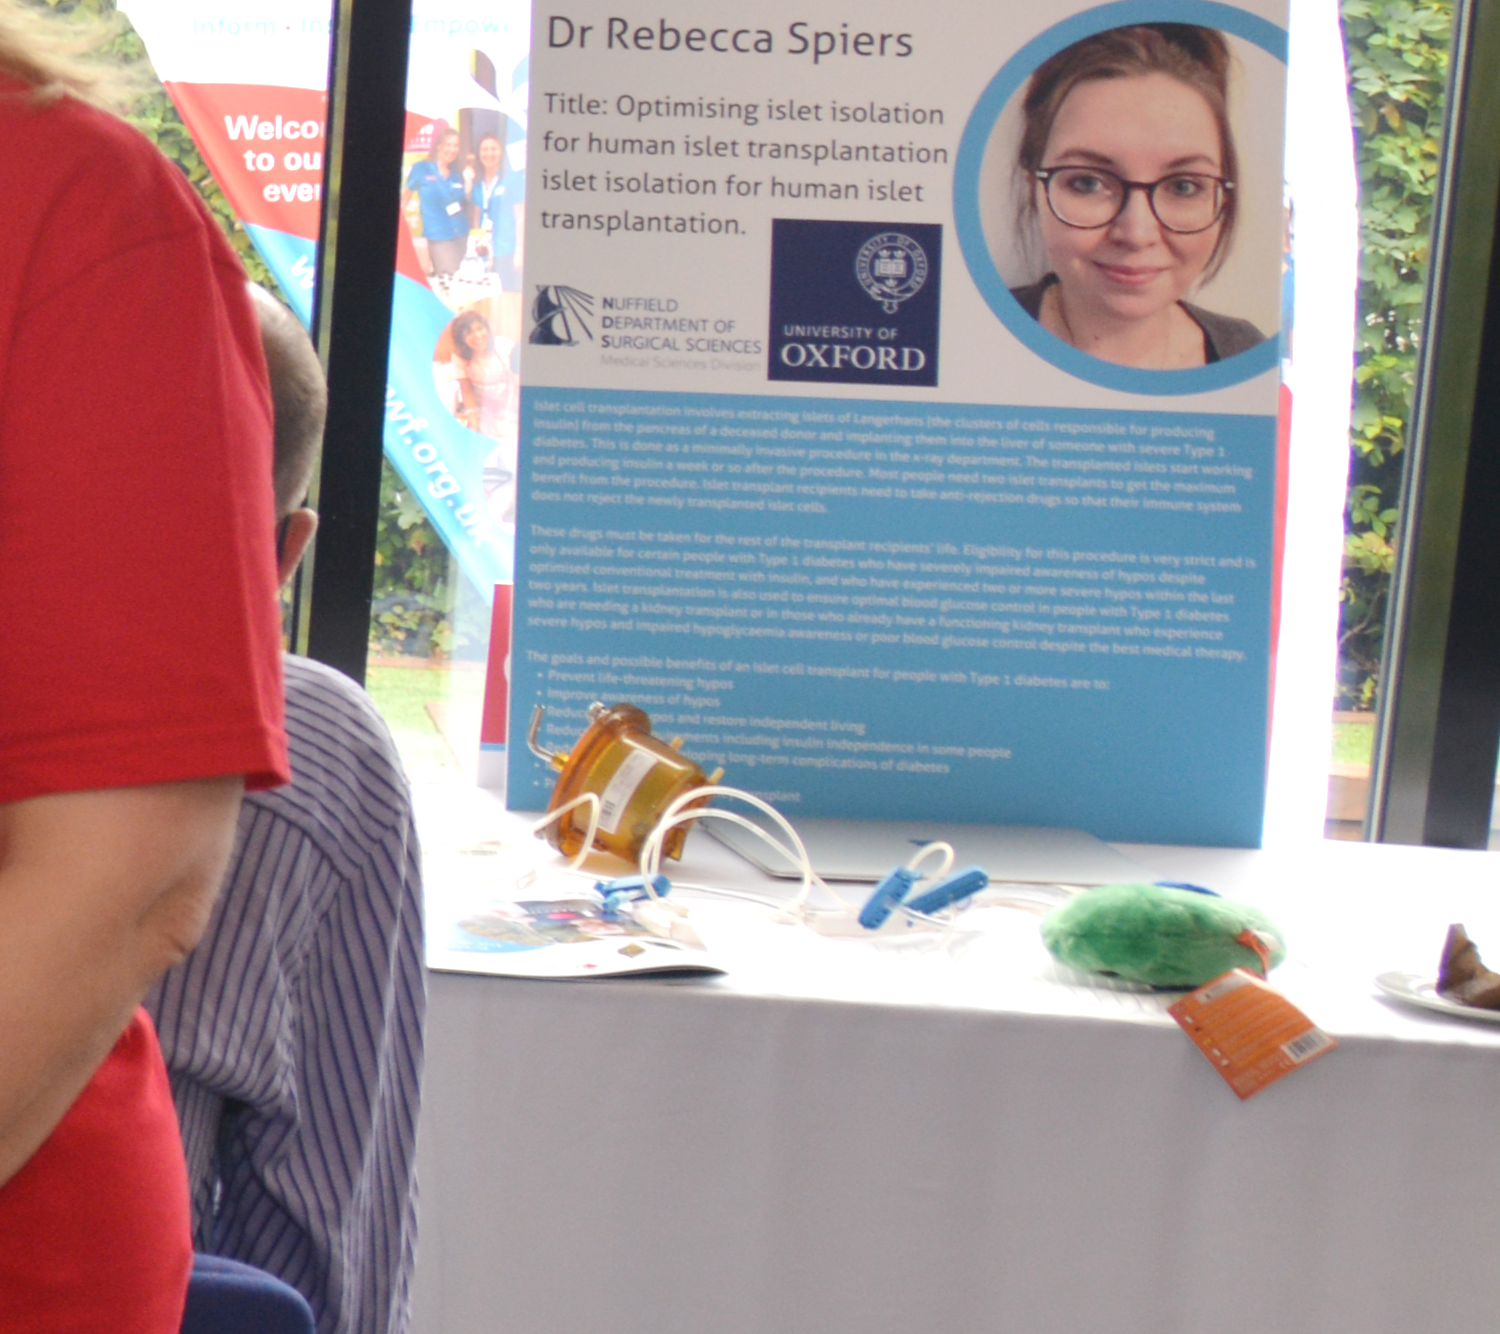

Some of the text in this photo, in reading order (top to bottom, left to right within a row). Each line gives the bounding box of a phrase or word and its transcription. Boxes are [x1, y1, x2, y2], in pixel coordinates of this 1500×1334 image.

[548, 15, 912, 62] Dr Rebecca Spiers
[543, 92, 943, 126] Title: Optimising islet isolation
[542, 130, 947, 166] for human islet transplantation
[541, 168, 923, 202] islet isolation for human islet
[540, 209, 745, 236] transplantation.
[602, 297, 677, 312] NUFFIELD
[601, 315, 733, 333] DEPARTMENT OF
[783, 324, 897, 340] UNIVERSITY OF
[600, 334, 761, 354] SURGICAL SCIENCES
[780, 343, 925, 371] OXFORD
